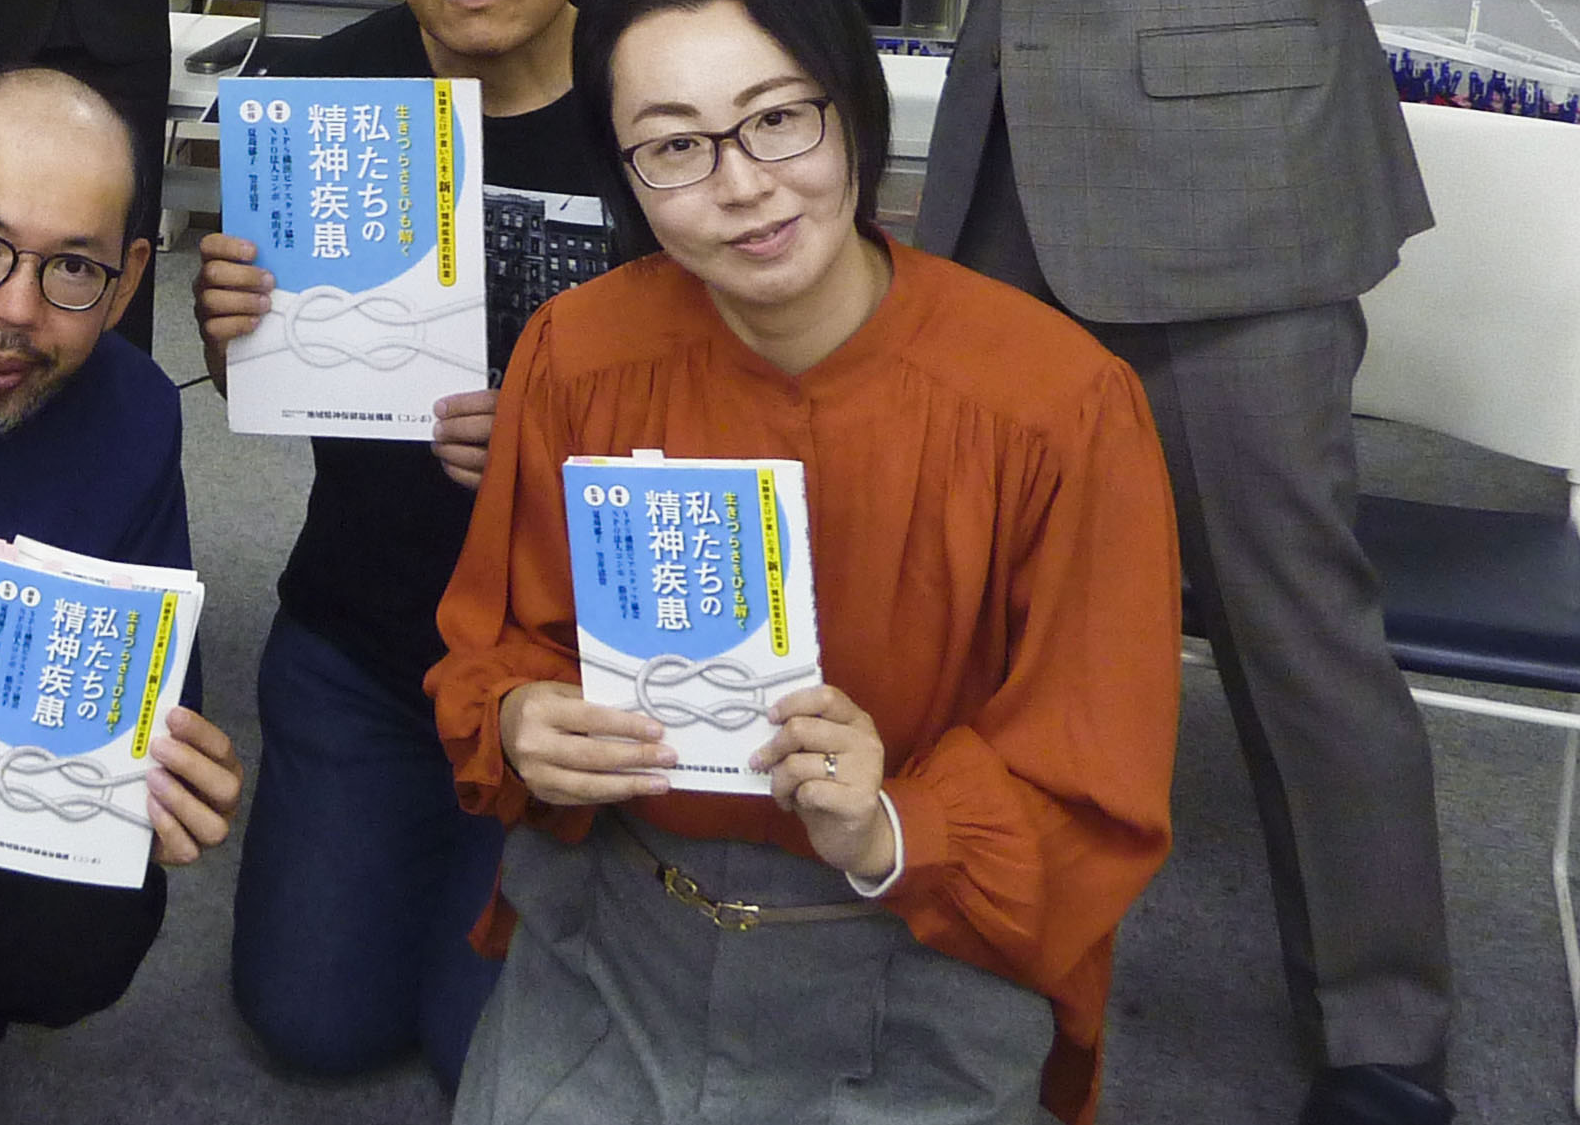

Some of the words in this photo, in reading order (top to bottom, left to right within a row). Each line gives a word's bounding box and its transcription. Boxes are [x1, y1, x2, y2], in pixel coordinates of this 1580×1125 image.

[308, 103, 351, 259] 精神疾患
[352, 104, 391, 242] 私たちの
[644, 489, 692, 631] 精神疾患
[684, 490, 724, 616] 私たちの
[31, 597, 88, 728] 精神疾患
[76, 606, 119, 721] 私たちの
